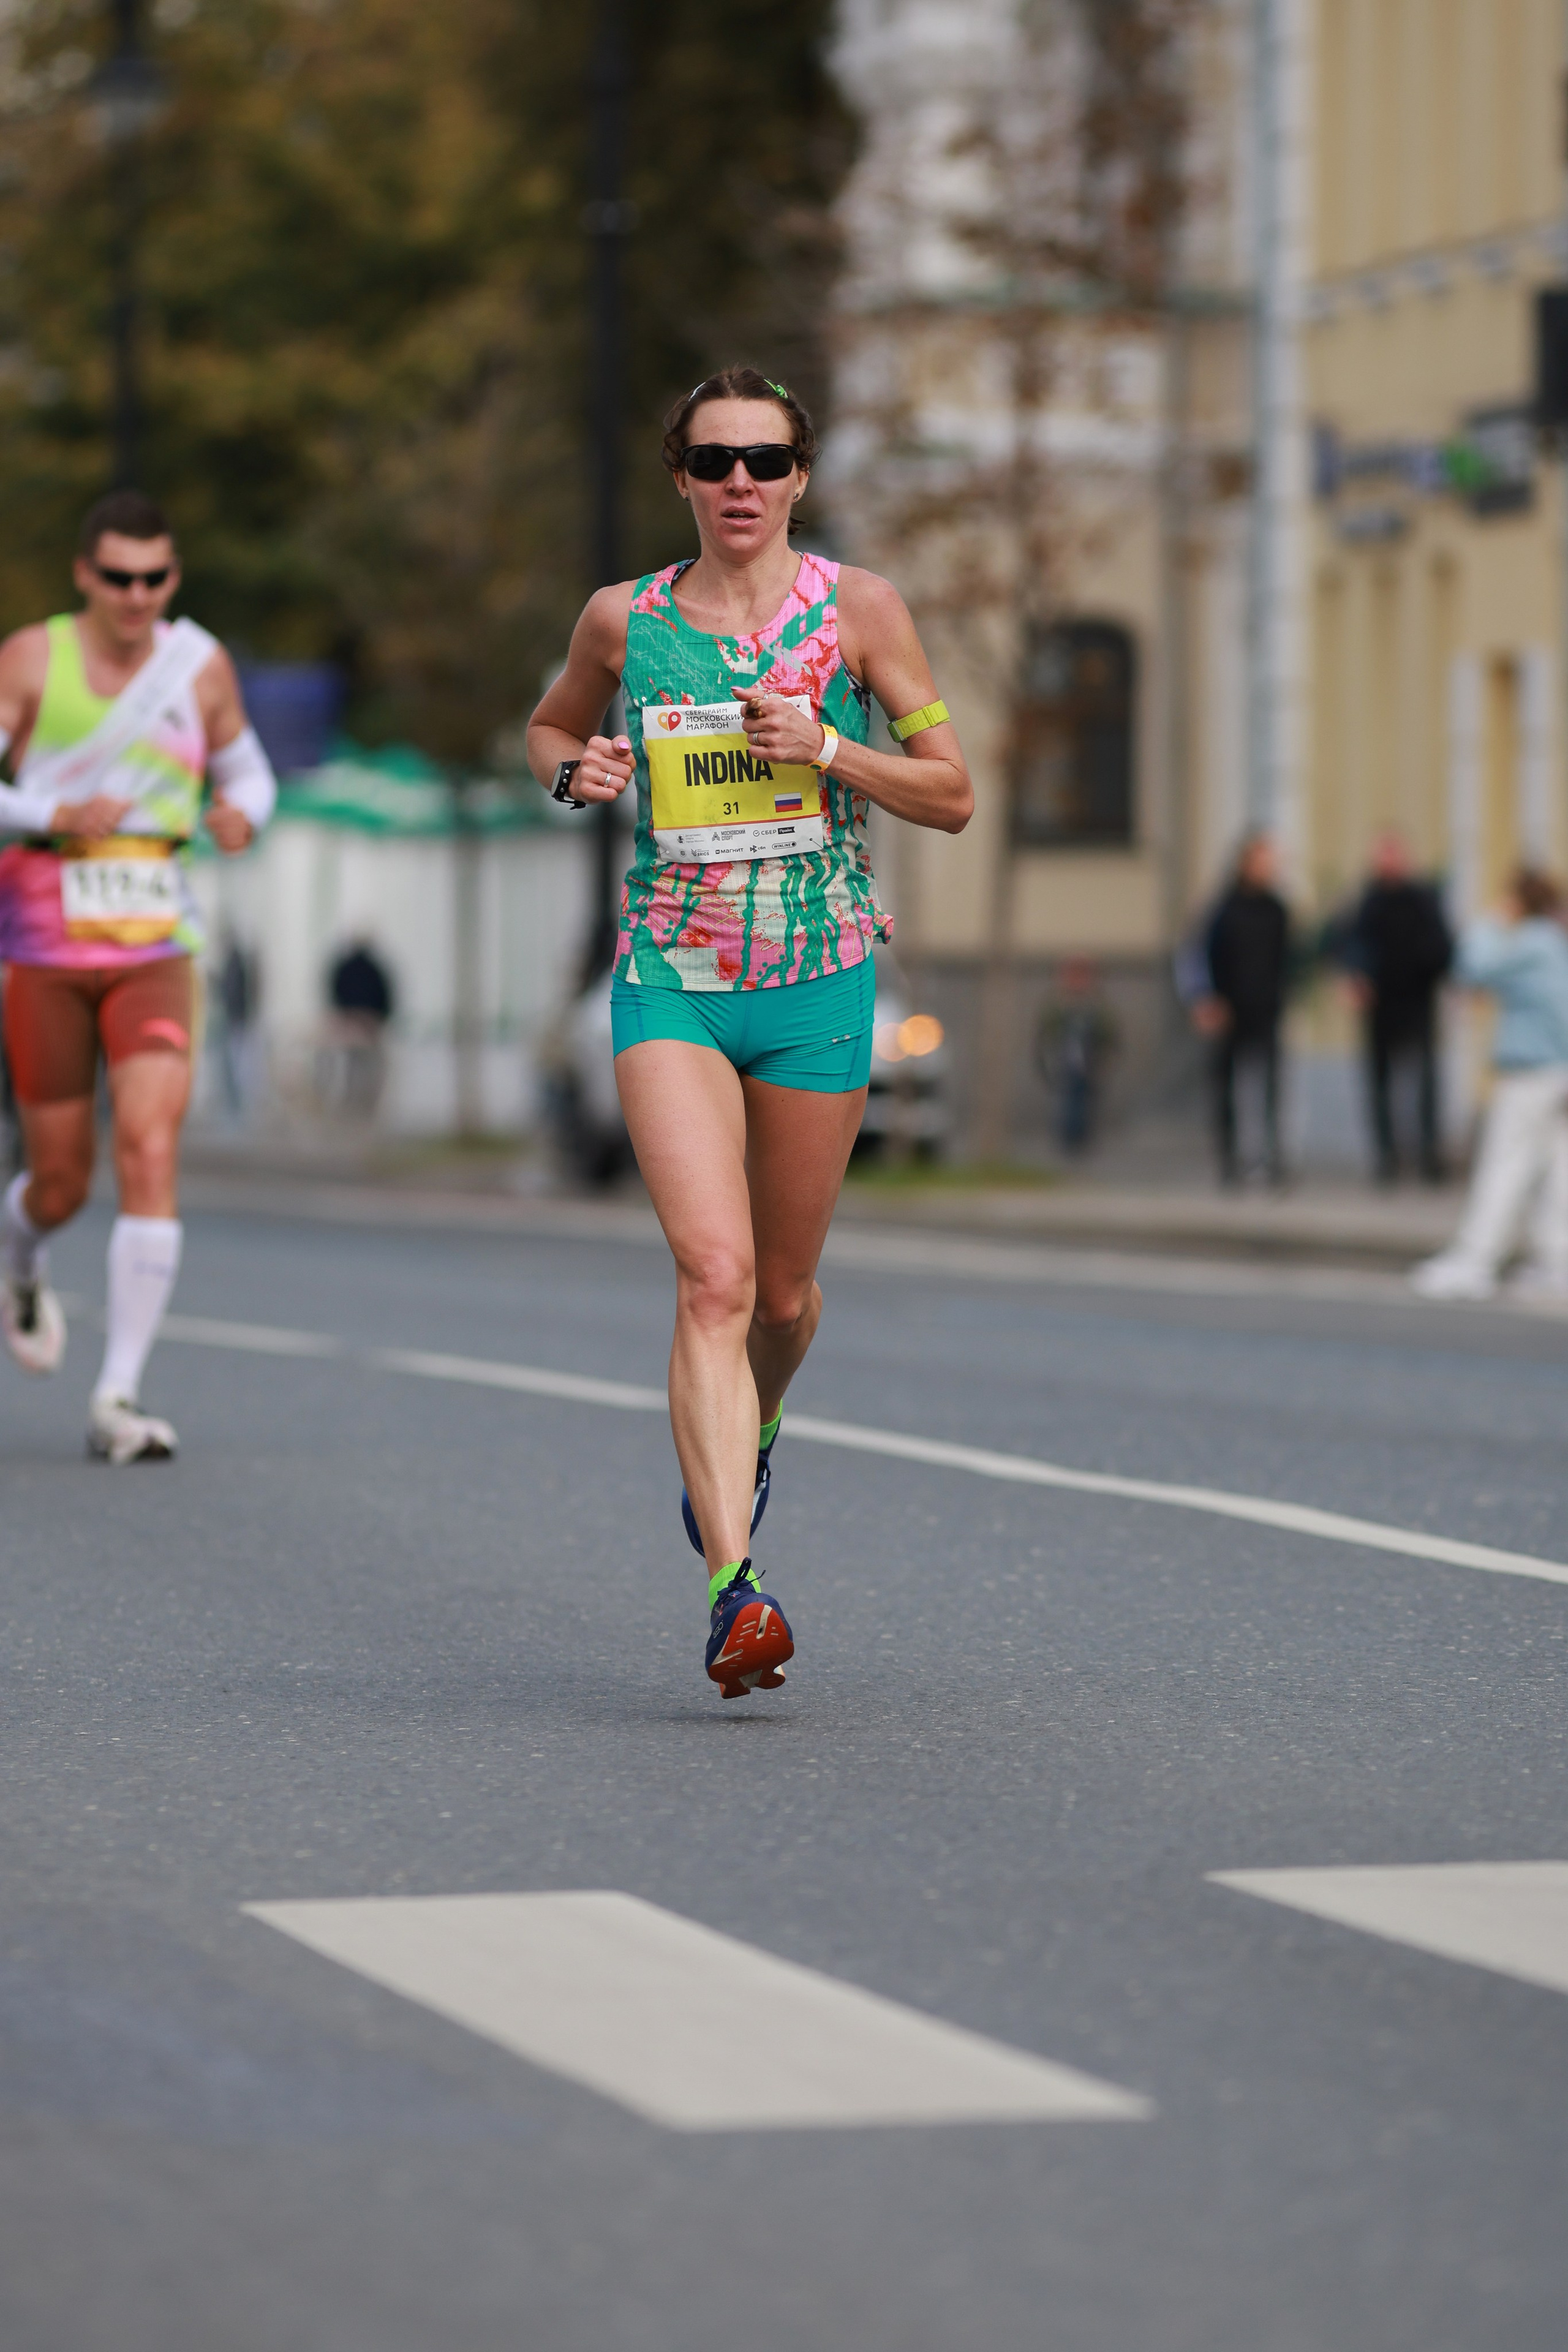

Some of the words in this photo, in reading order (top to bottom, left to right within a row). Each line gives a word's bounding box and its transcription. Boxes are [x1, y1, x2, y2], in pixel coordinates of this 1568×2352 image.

[686, 712, 743, 723] МОСКОВСКИЙ
[687, 722, 729, 731] МАРАФОН
[684, 750, 774, 786] INDINA
[723, 802, 739, 815] 31
